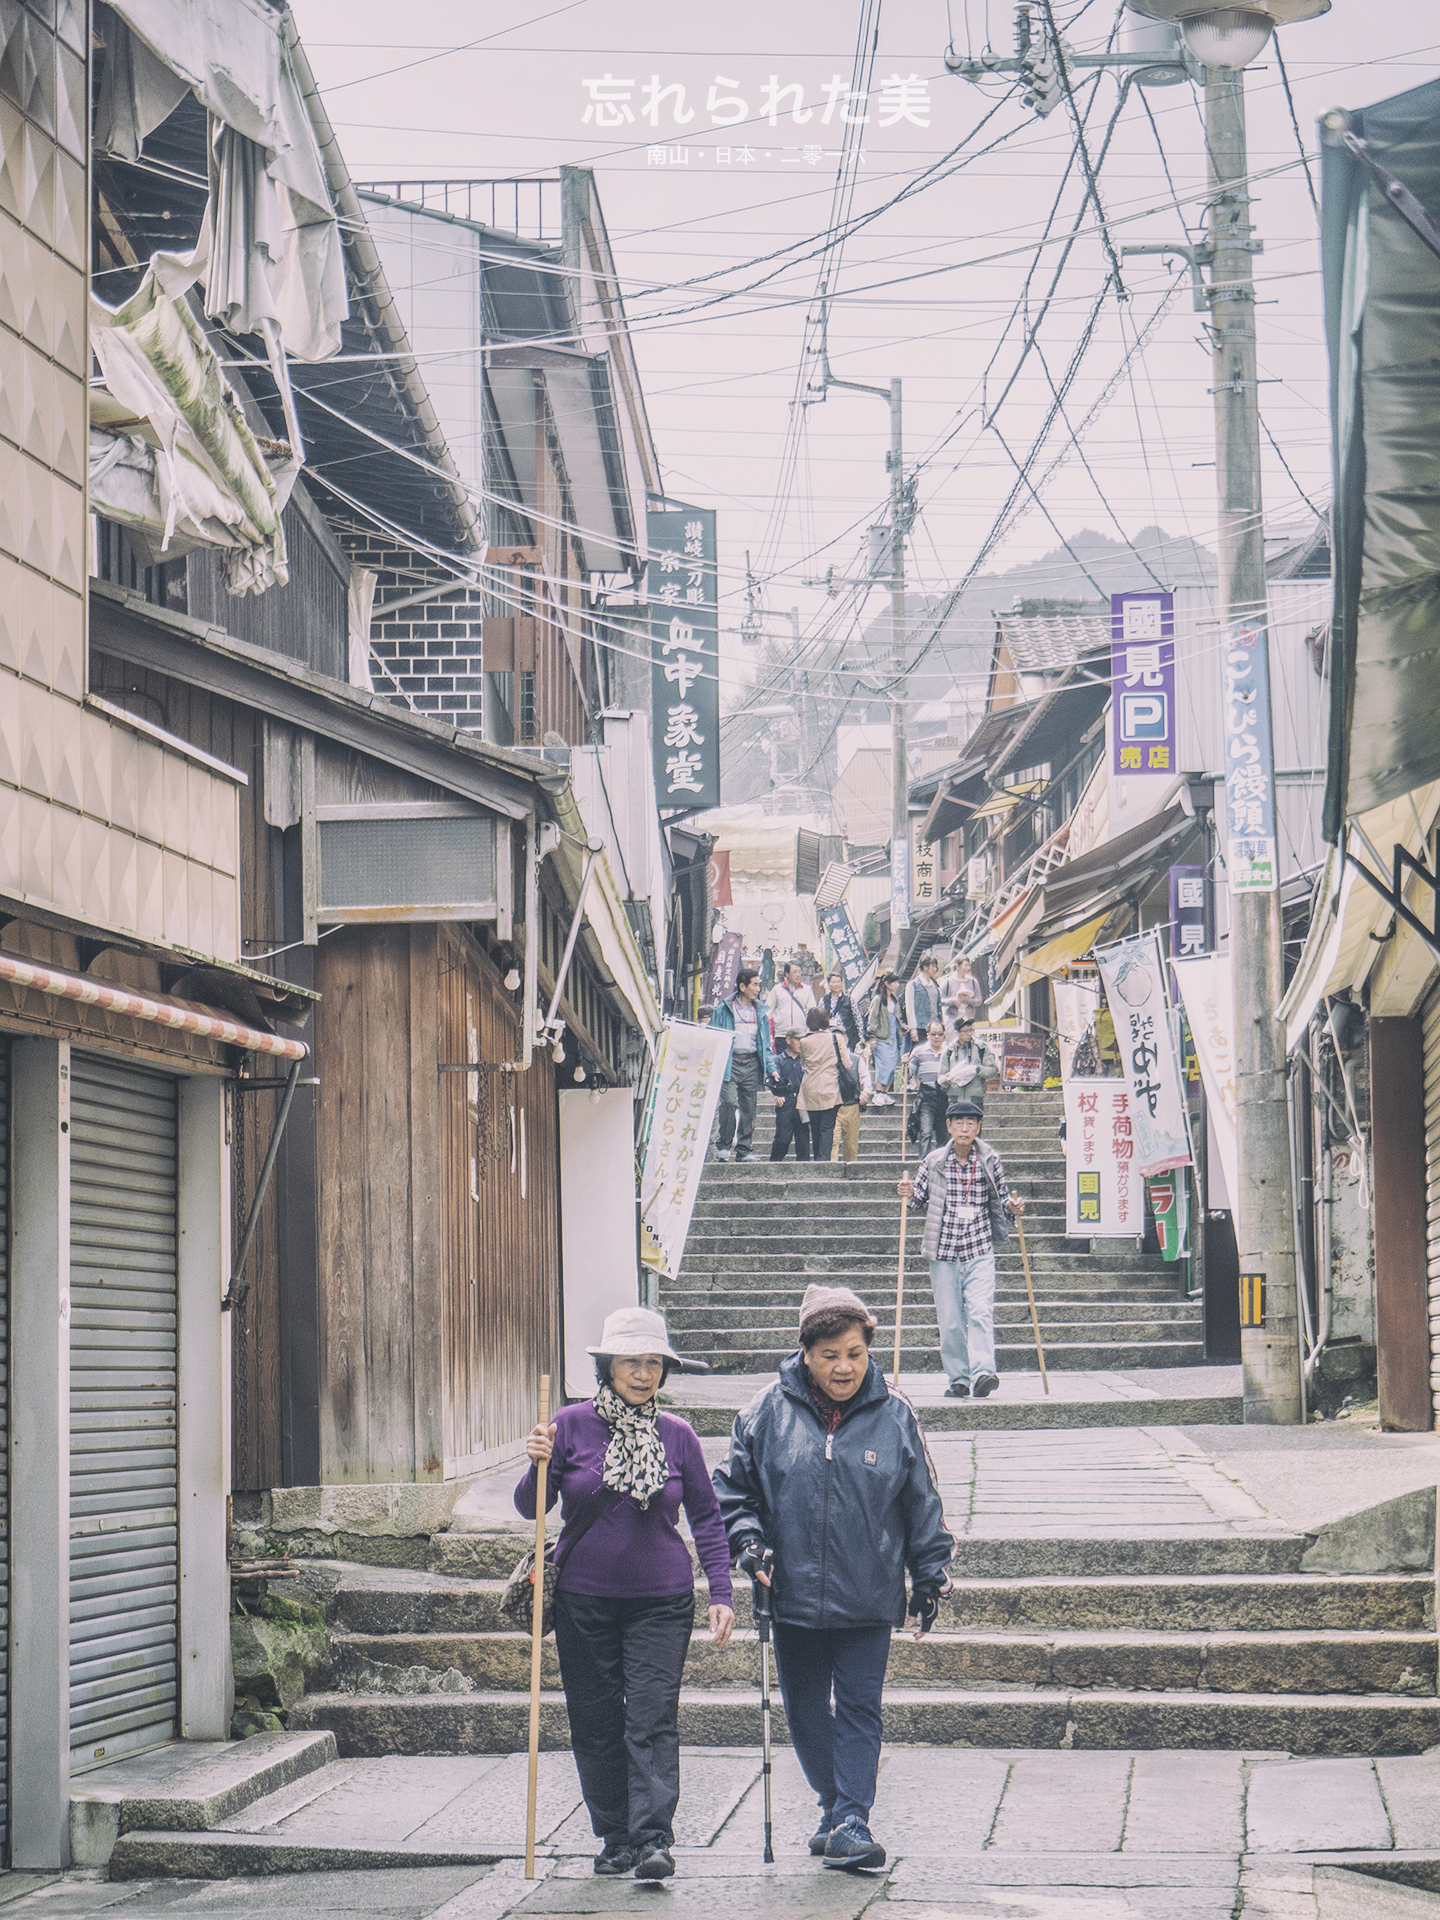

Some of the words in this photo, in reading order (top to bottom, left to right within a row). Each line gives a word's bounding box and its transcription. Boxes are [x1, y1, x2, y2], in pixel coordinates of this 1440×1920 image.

[658, 549, 682, 607] 宗家
[1122, 600, 1164, 688] 國見
[1124, 698, 1163, 737] P
[1120, 746, 1170, 769] 売店
[915, 824, 934, 898] 枝商店
[1077, 1092, 1099, 1165] 杖貸します
[1111, 1093, 1134, 1224] 手荷物預かります
[1078, 1173, 1100, 1222] 国見
